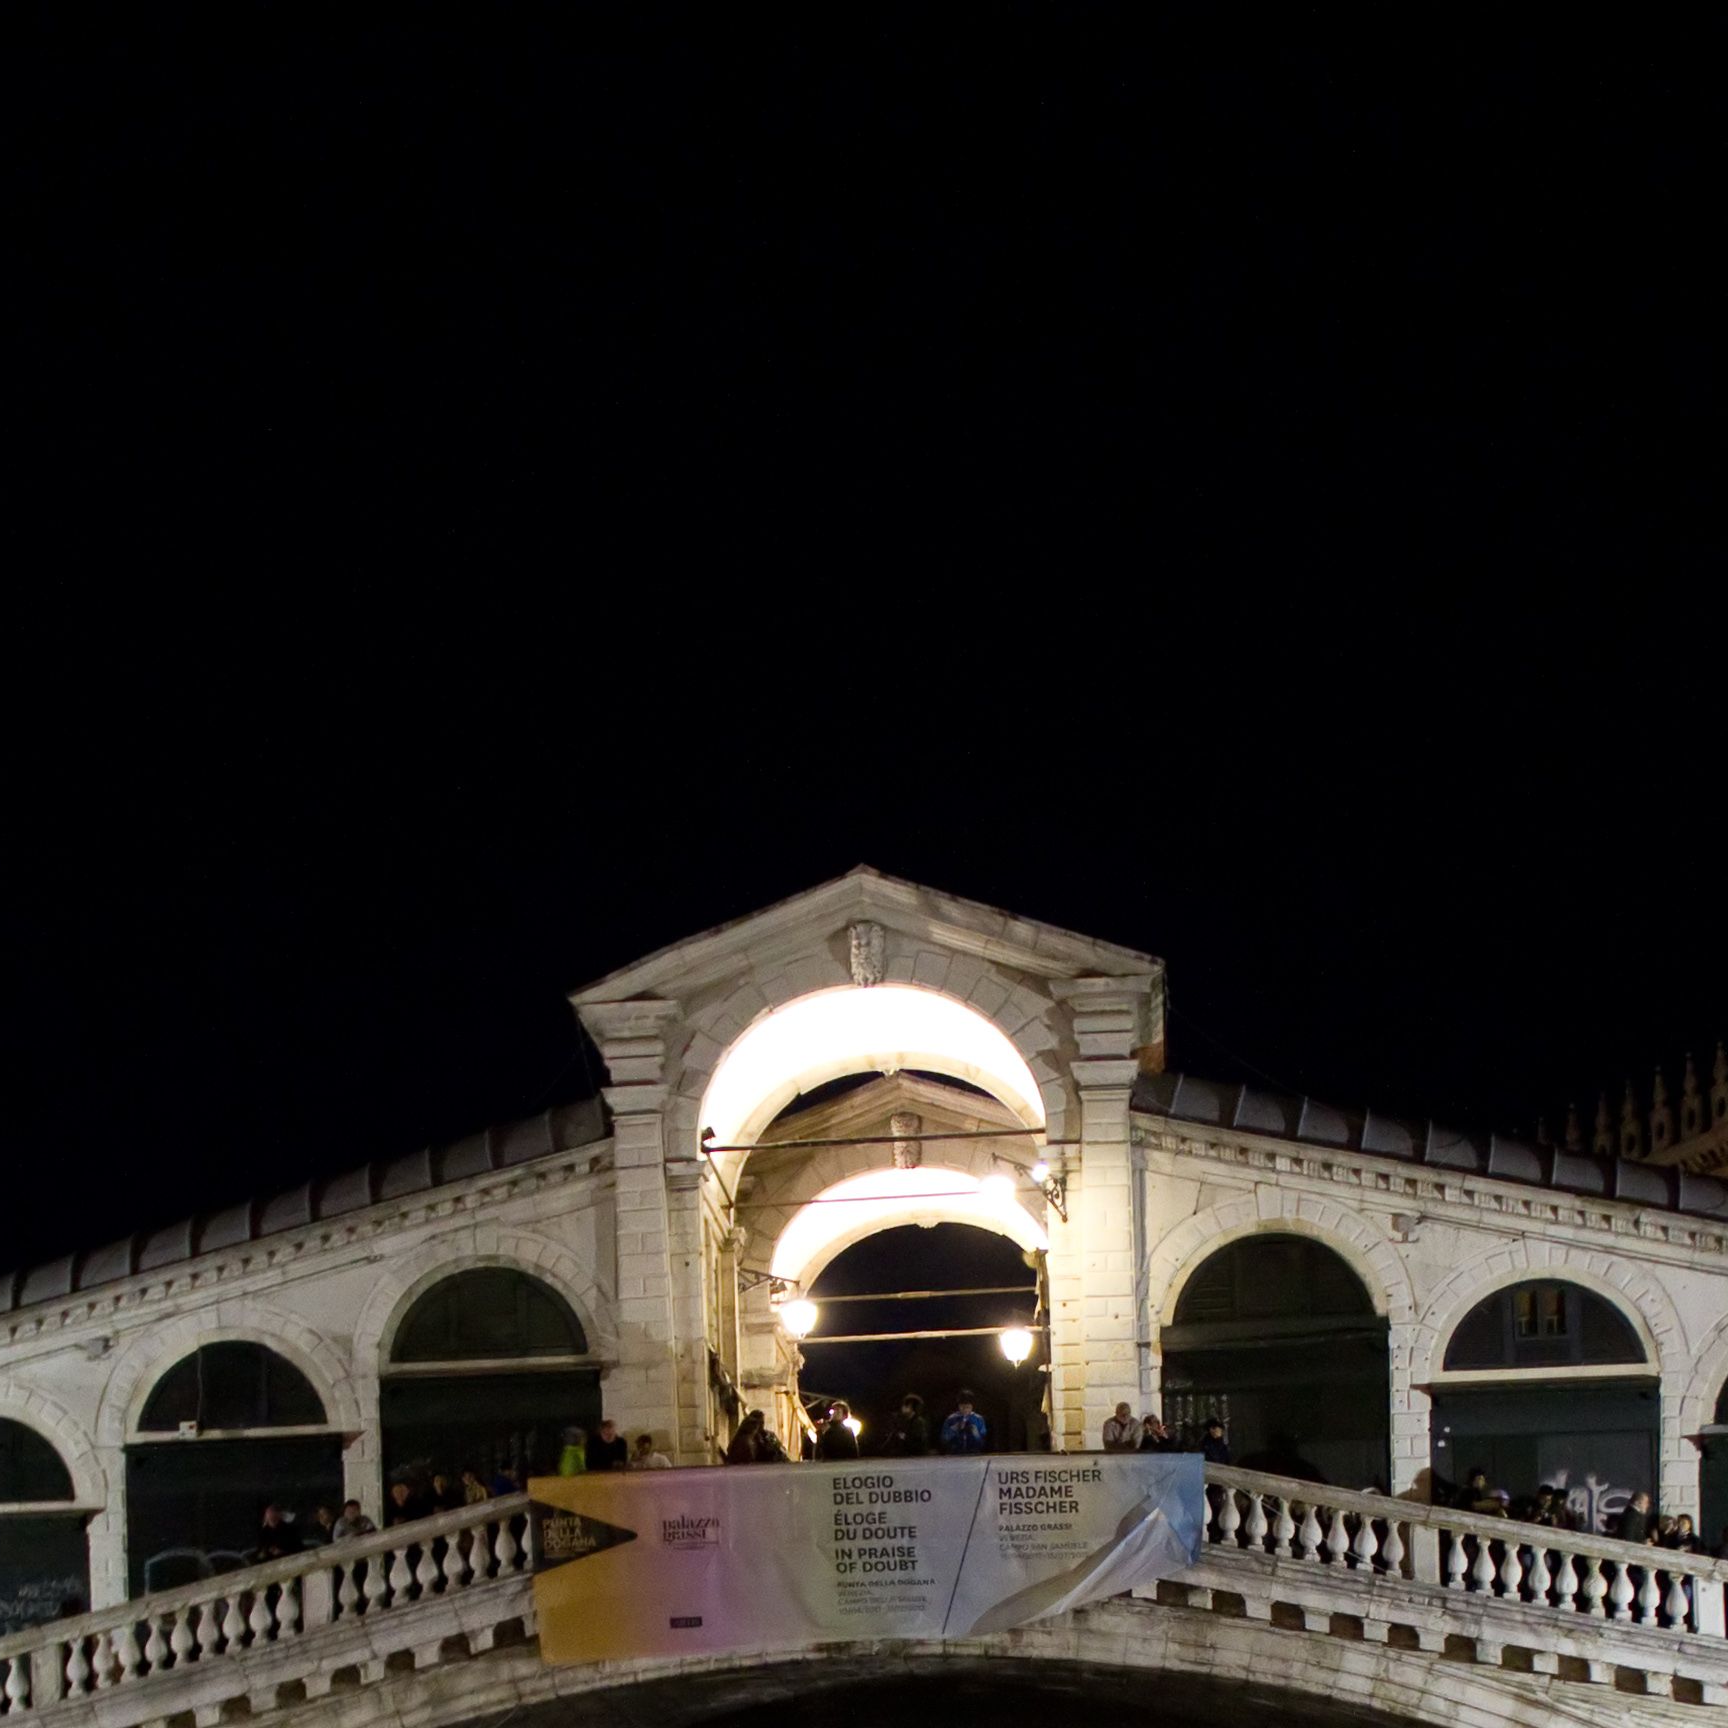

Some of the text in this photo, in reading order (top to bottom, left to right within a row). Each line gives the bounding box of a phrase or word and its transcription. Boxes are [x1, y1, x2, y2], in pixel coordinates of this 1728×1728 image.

[832, 1475, 894, 1490] ELOGIO
[997, 1469, 1102, 1485] URS FISCHER
[833, 1489, 932, 1505] DEL DUBBIO
[998, 1485, 1074, 1500] MADAME
[999, 1500, 1080, 1515] FISSCHER
[663, 1515, 720, 1532] palazzo
[833, 1510, 888, 1526] ÉLOGE
[834, 1526, 917, 1541] DU DOUTE
[998, 1523, 1073, 1533] PALAZZO GRASSI
[835, 1546, 917, 1560] IN PRAISE
[835, 1560, 919, 1574] OF DOUBT
[836, 1580, 867, 1589] PUNTA
[897, 1578, 936, 1587] DOGANA
